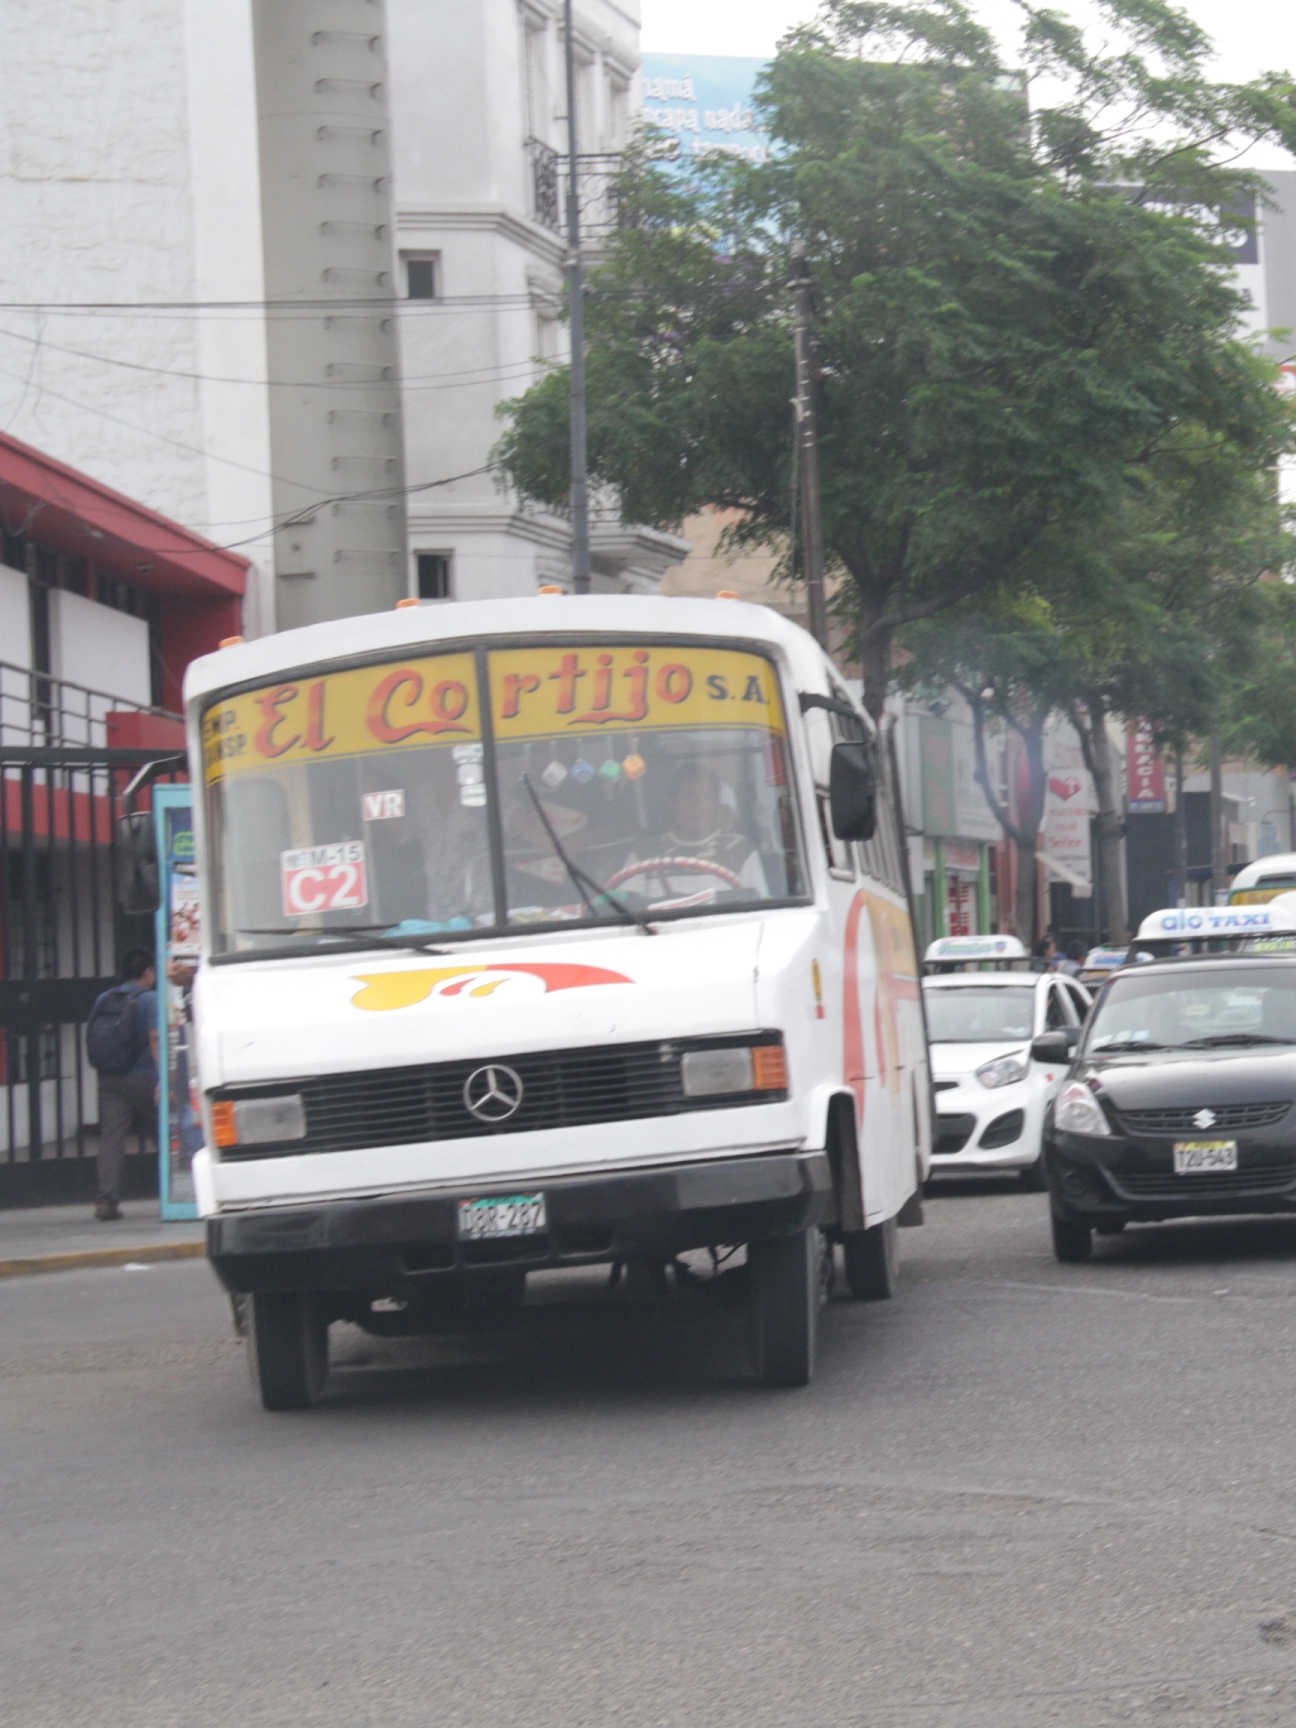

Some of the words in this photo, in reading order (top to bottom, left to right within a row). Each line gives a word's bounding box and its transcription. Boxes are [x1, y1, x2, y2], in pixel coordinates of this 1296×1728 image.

[253, 679, 335, 758] El
[366, 650, 694, 744] Cortijo
[364, 793, 403, 816] VR
[289, 863, 360, 911] C2
[1208, 913, 1272, 929] TAXI
